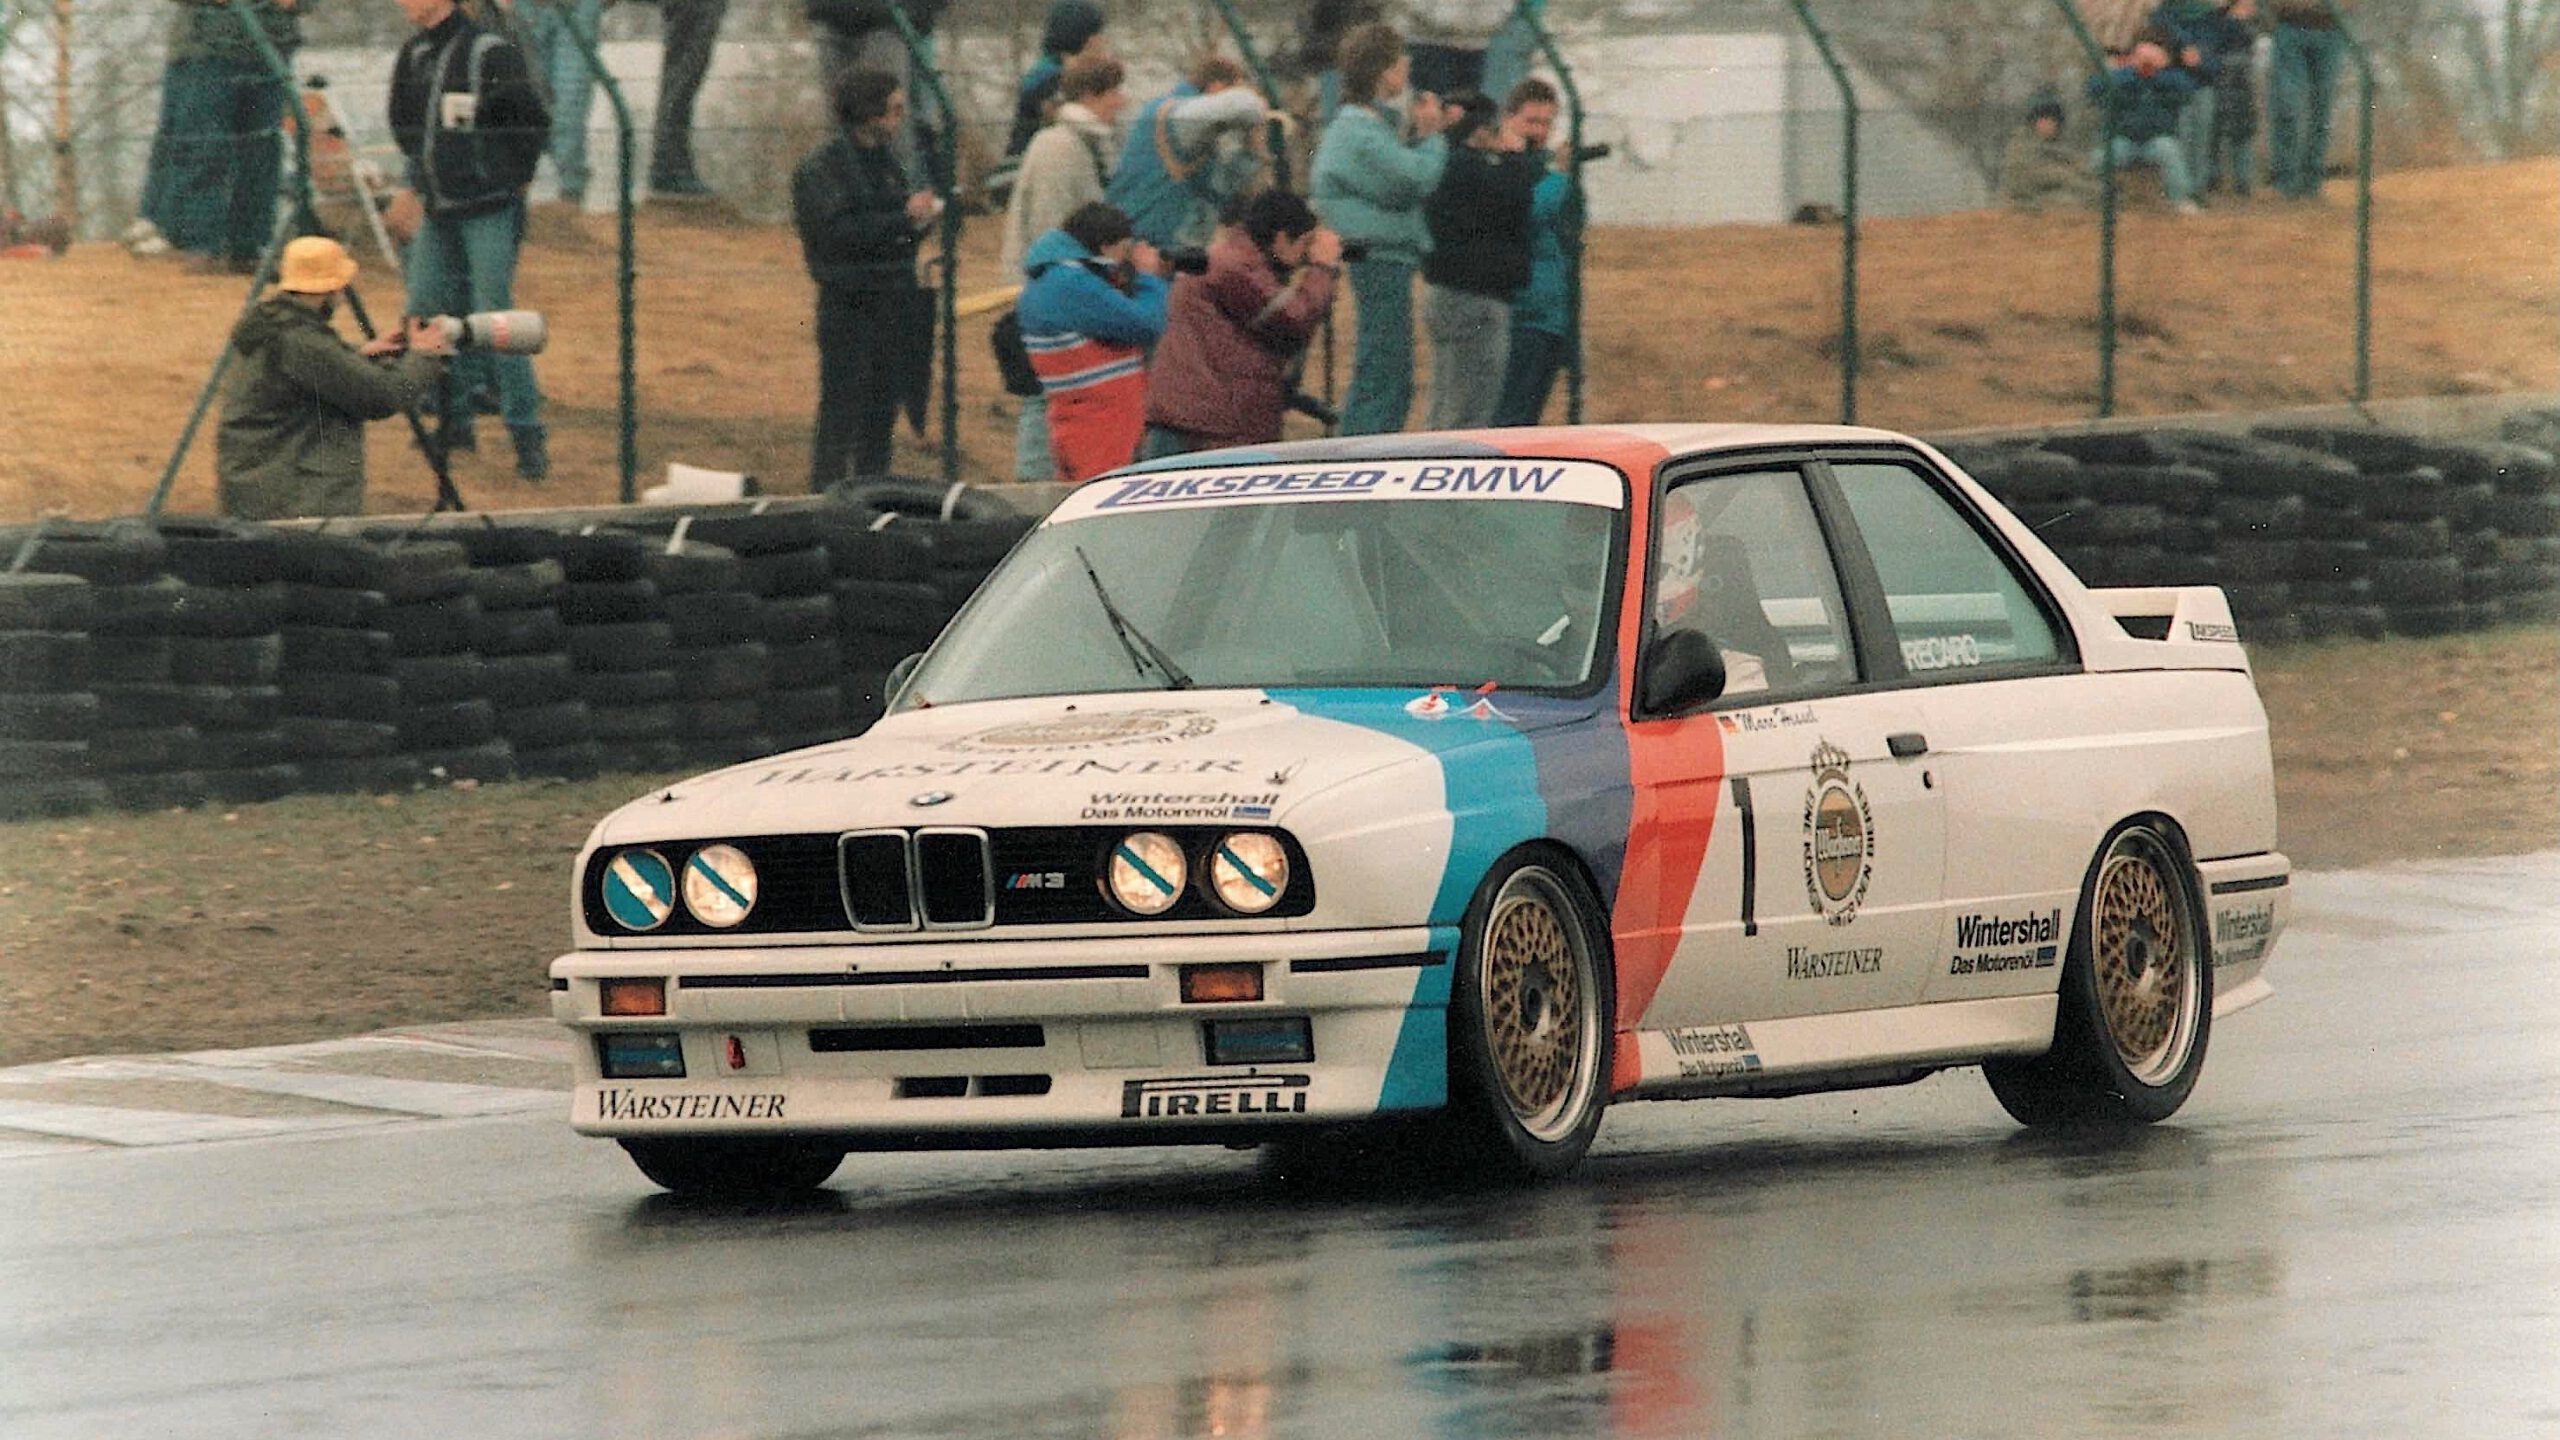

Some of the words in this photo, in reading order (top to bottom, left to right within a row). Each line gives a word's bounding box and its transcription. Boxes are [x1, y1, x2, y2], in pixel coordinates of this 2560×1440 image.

[1094, 470, 1387, 509] ZAKSPEED
[1410, 466, 1567, 493] BMW
[1900, 633, 1980, 673] RECARO
[1081, 806, 1119, 819] Das
[1124, 804, 1228, 819] Motorenöl
[1090, 791, 1280, 805] Wintershall
[1731, 777, 1758, 937] 1
[1957, 908, 2061, 948] Wintershall
[1787, 945, 1883, 980] WARSTEINER
[1950, 955, 1975, 975] Das
[598, 1087, 786, 1120] WARSTEINER
[1121, 1074, 1311, 1118] PIRELLI
